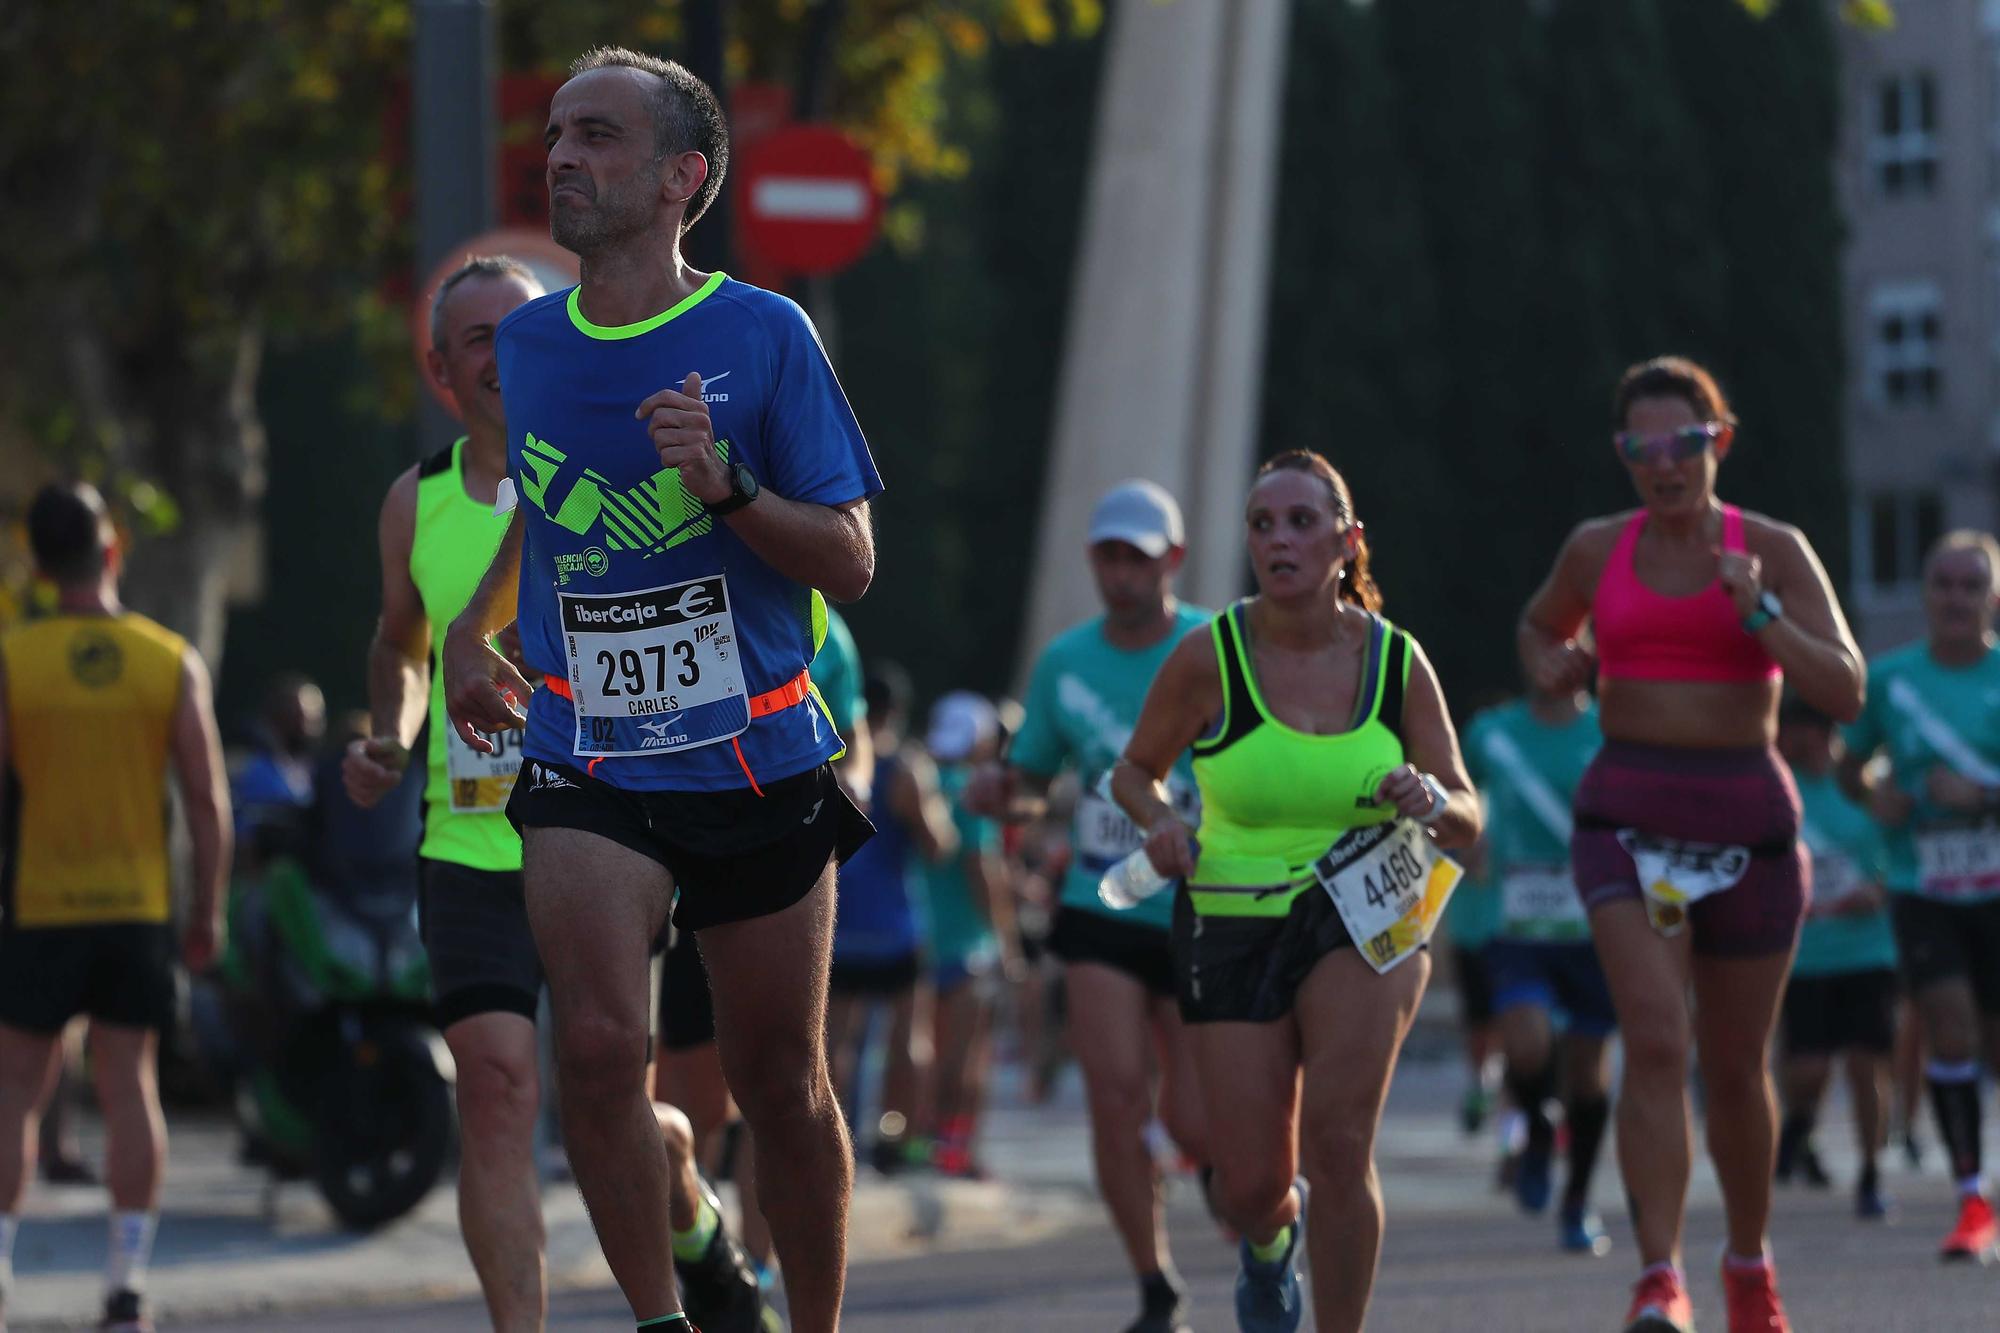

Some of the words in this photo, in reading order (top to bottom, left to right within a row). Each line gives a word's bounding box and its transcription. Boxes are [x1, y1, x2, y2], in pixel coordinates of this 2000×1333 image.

[574, 602, 658, 625] iberCaja
[596, 639, 700, 697] 2973
[628, 695, 679, 715] CARLES
[592, 716, 616, 743] 02
[1363, 844, 1423, 909] 4460
[1370, 929, 1396, 958] 02
